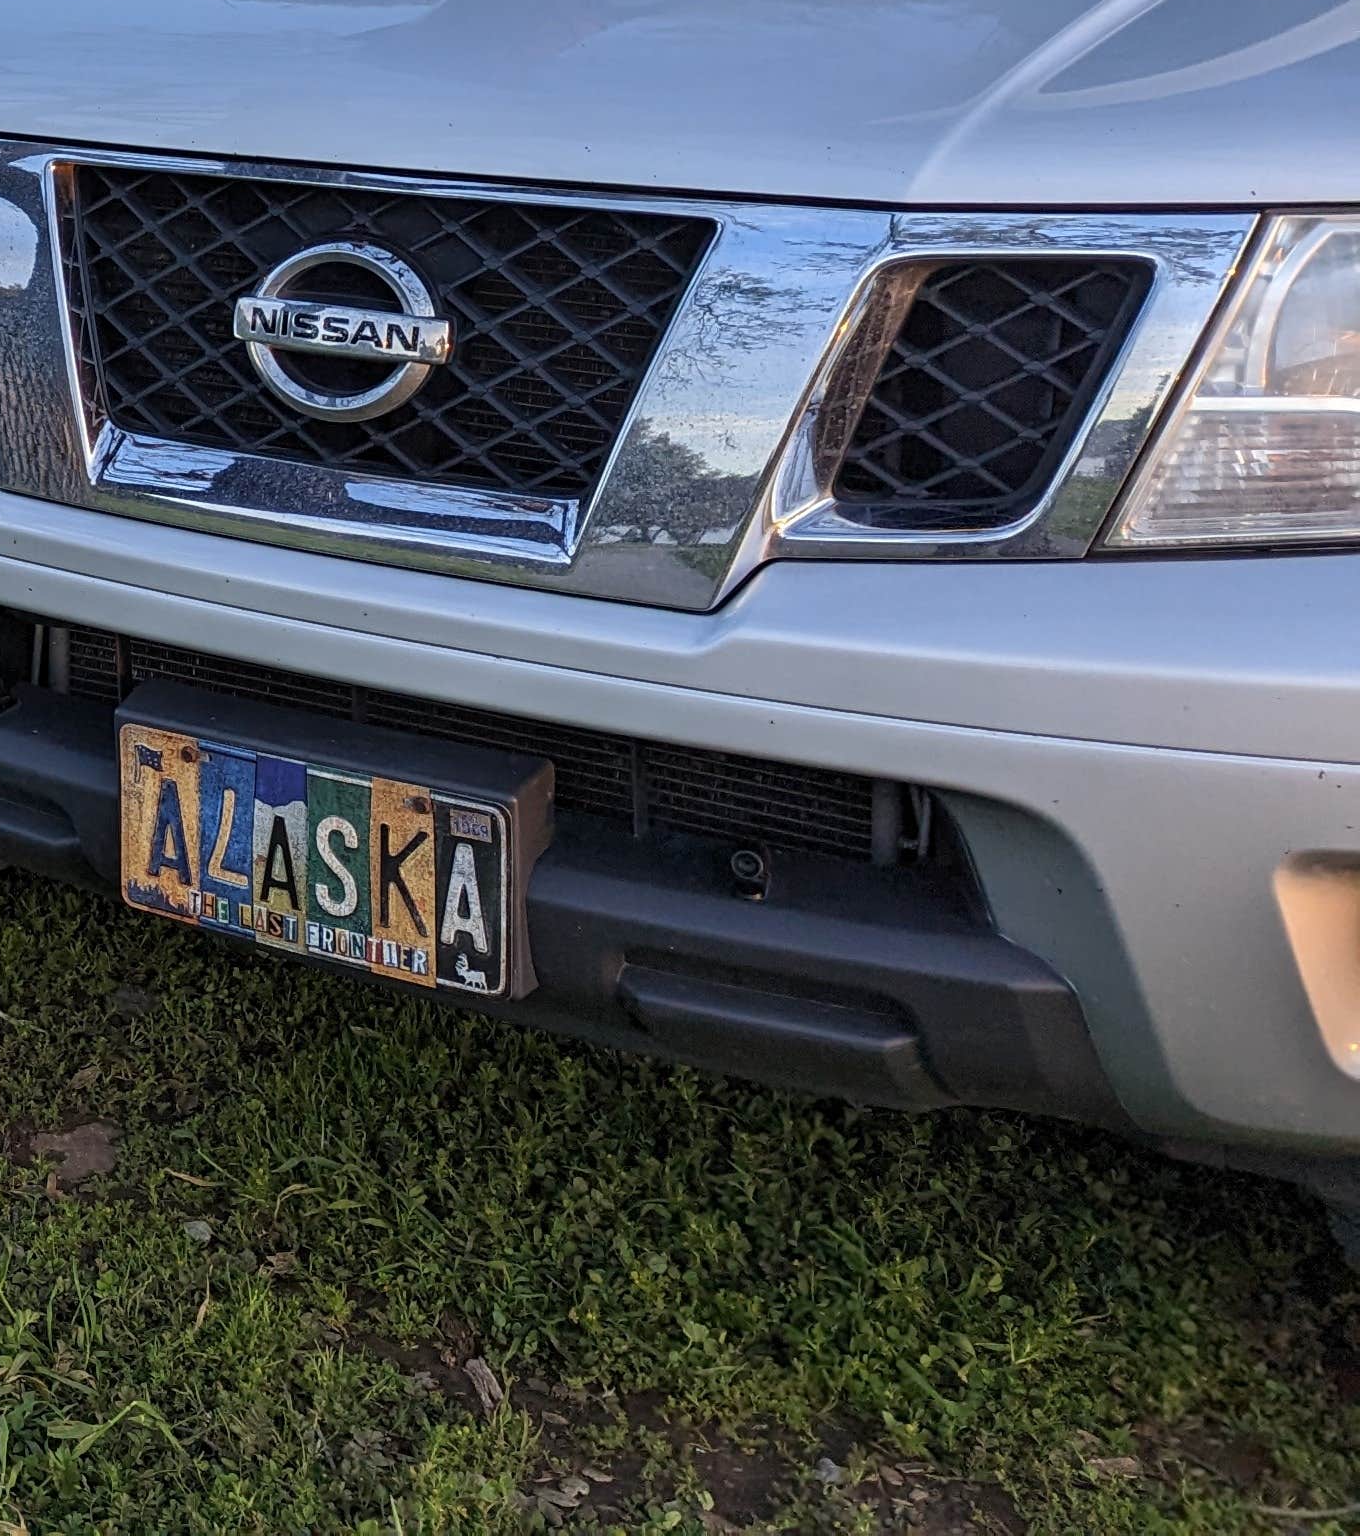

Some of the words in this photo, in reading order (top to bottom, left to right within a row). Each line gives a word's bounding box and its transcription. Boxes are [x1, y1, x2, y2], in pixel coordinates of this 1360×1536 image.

[250, 306, 420, 353] NISSAN
[147, 777, 489, 954] ALASKA
[191, 890, 229, 924] THE
[239, 904, 298, 942] LAST
[306, 923, 429, 976] FRONTIER
